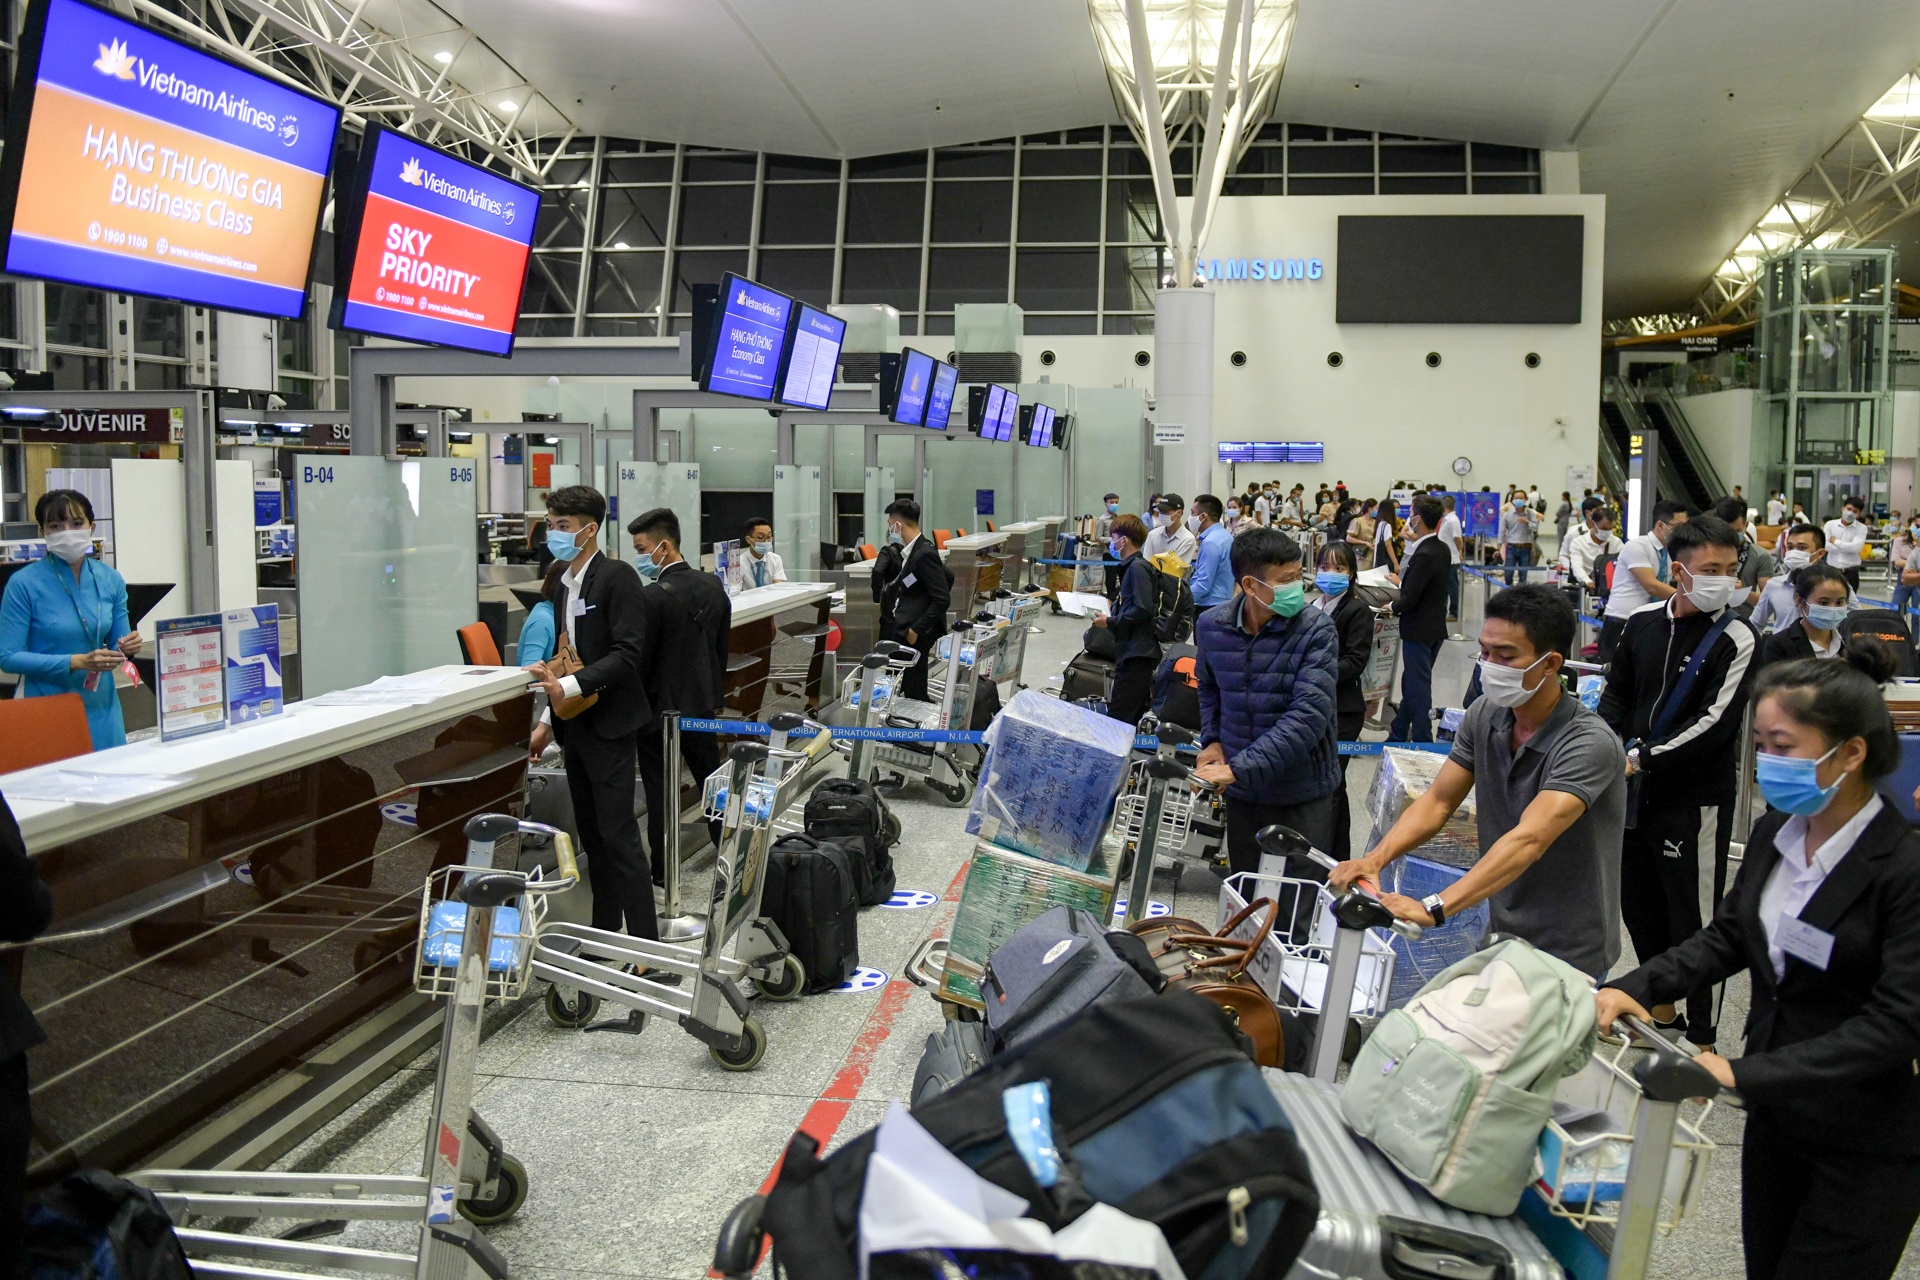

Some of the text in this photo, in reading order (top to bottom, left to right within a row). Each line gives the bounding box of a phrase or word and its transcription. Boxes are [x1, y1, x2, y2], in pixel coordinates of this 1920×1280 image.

[82, 123, 283, 209] HẠNG THƯƠNG GIA
[110, 173, 253, 235] Business Class
[386, 222, 433, 257] SKY
[103, 229, 258, 272] 1900 1100 www.vietnamairlines.com
[732, 345, 766, 365] Economy Class
[40, 413, 147, 433] OUVENIR
[304, 466, 334, 483] B-04
[450, 467, 472, 482] B-05
[621, 468, 635, 480] B-06
[687, 469, 698, 480] B-07
[1384, 624, 1399, 632] DOR
[829, 728, 886, 738] TERNATIONAL
[887, 730, 925, 739] AIRPORT
[1338, 743, 1373, 752] IRPORT
